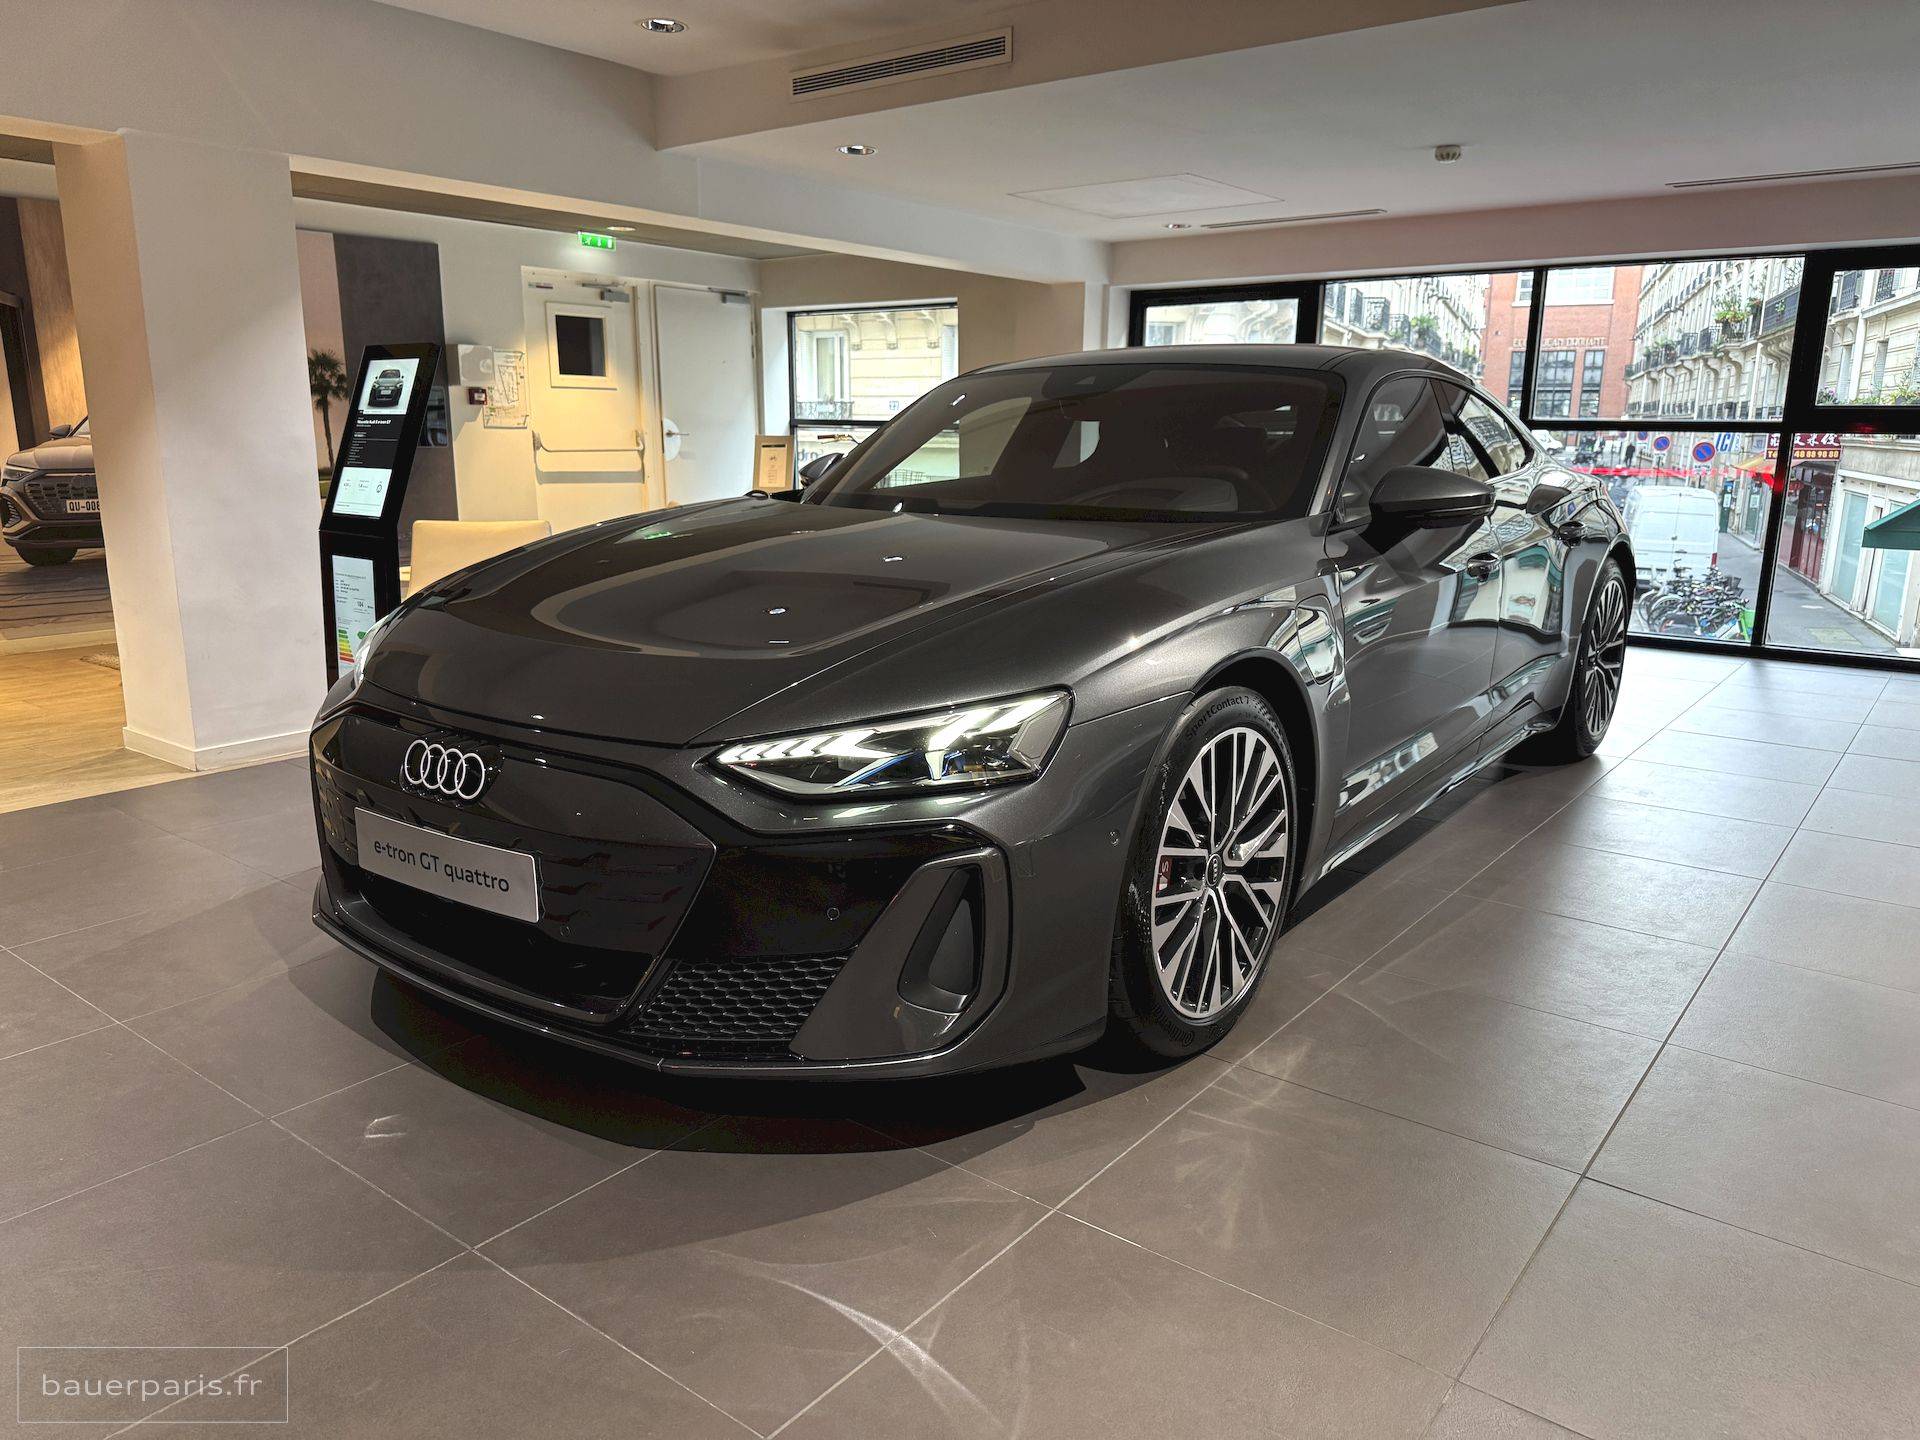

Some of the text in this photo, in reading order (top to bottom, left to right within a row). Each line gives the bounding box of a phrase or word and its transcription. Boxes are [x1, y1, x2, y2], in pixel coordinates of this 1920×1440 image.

[1186, 696, 1243, 739] SportContact
[374, 840, 510, 892] e-tron GT quattro
